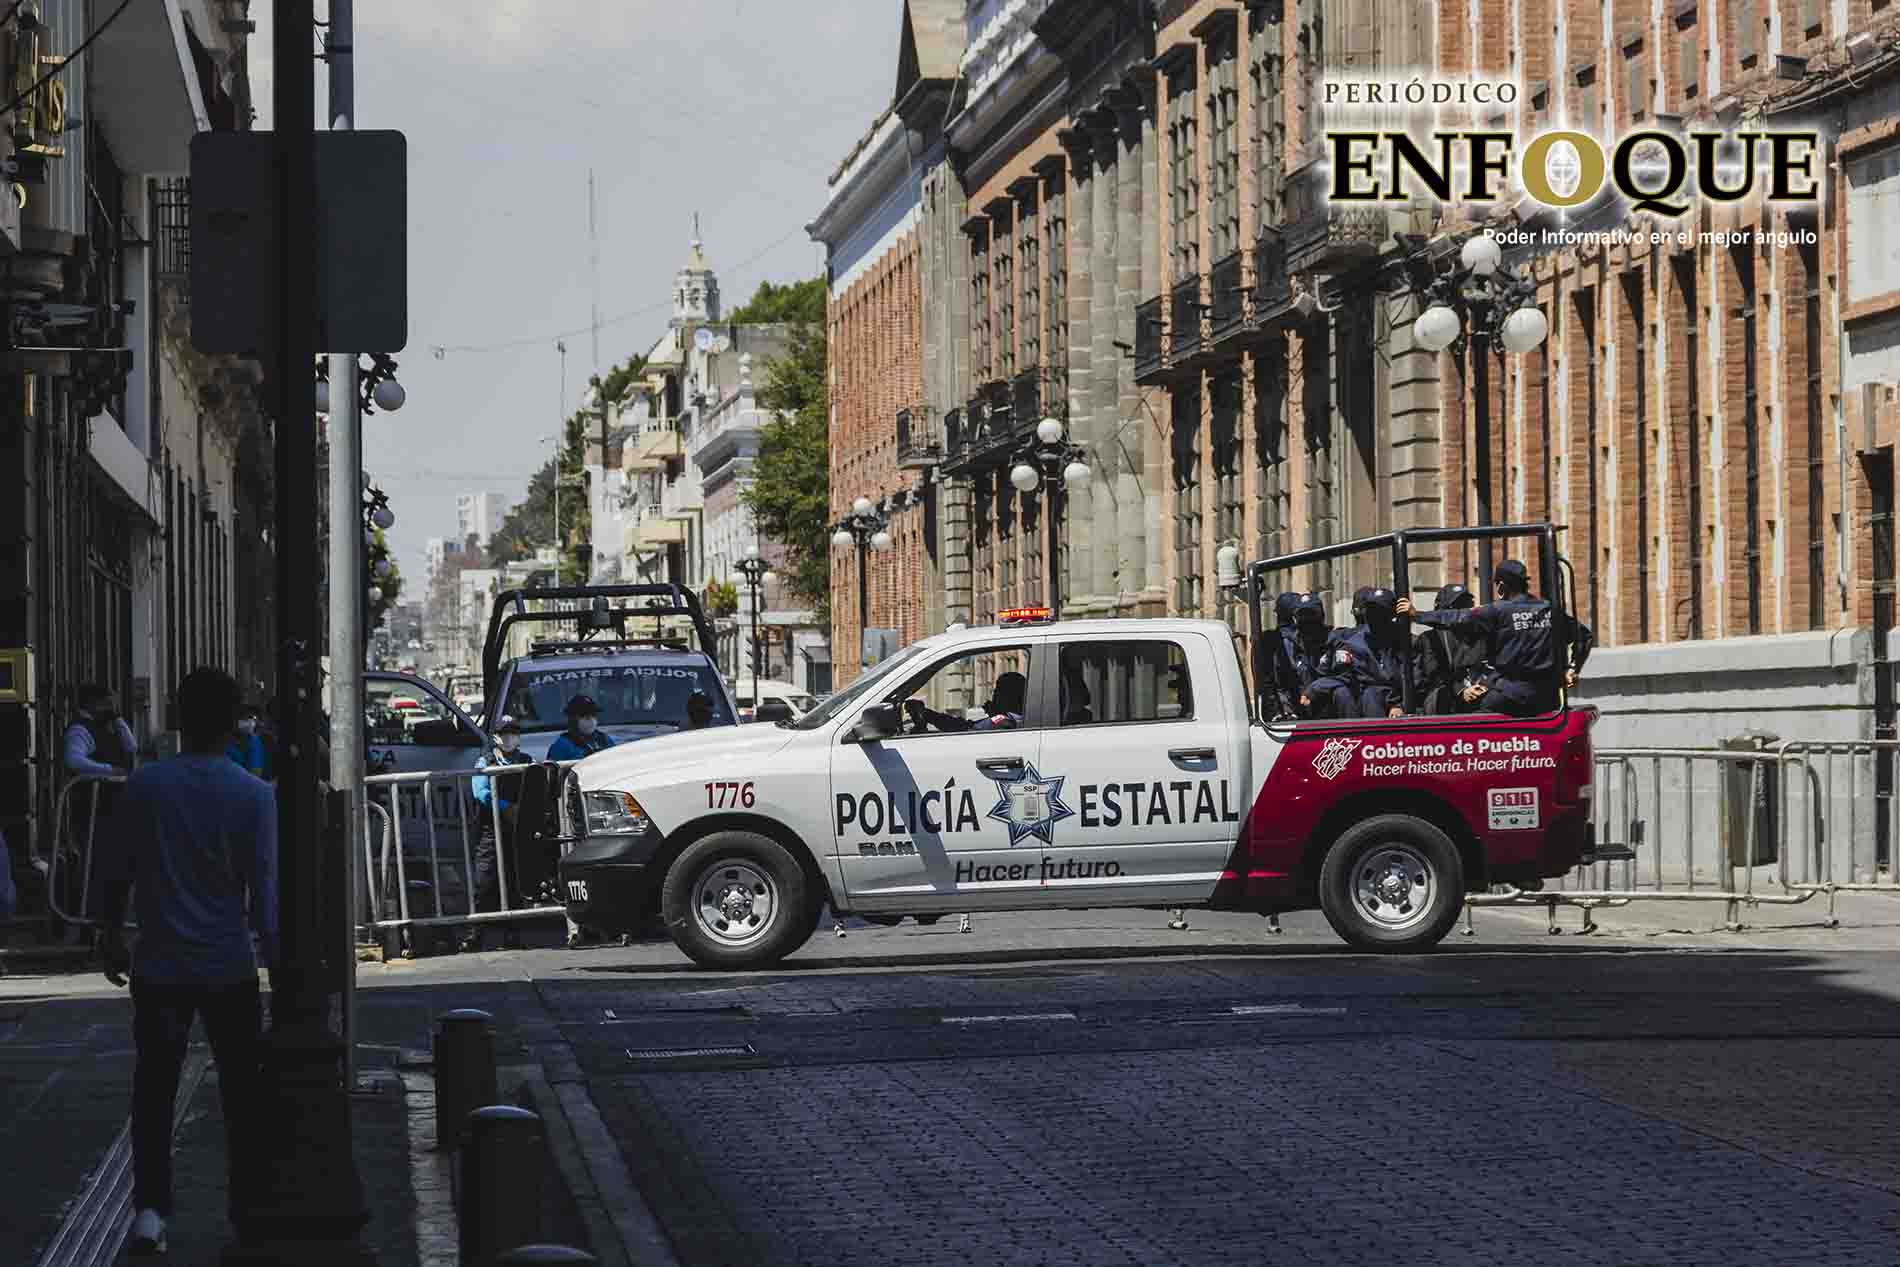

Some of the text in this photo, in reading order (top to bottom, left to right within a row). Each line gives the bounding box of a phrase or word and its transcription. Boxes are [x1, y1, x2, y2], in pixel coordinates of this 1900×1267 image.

[1361, 736, 1541, 760] Gobierno de Puebla
[1363, 755, 1557, 777] Hacer historia. Hacer futuro.
[704, 781, 756, 809] 1776
[836, 775, 1240, 837] POLICÍA ESTATAL
[1494, 793, 1532, 806] 911
[955, 855, 1126, 885] Hacer futuro.
[568, 880, 588, 902] 1776
